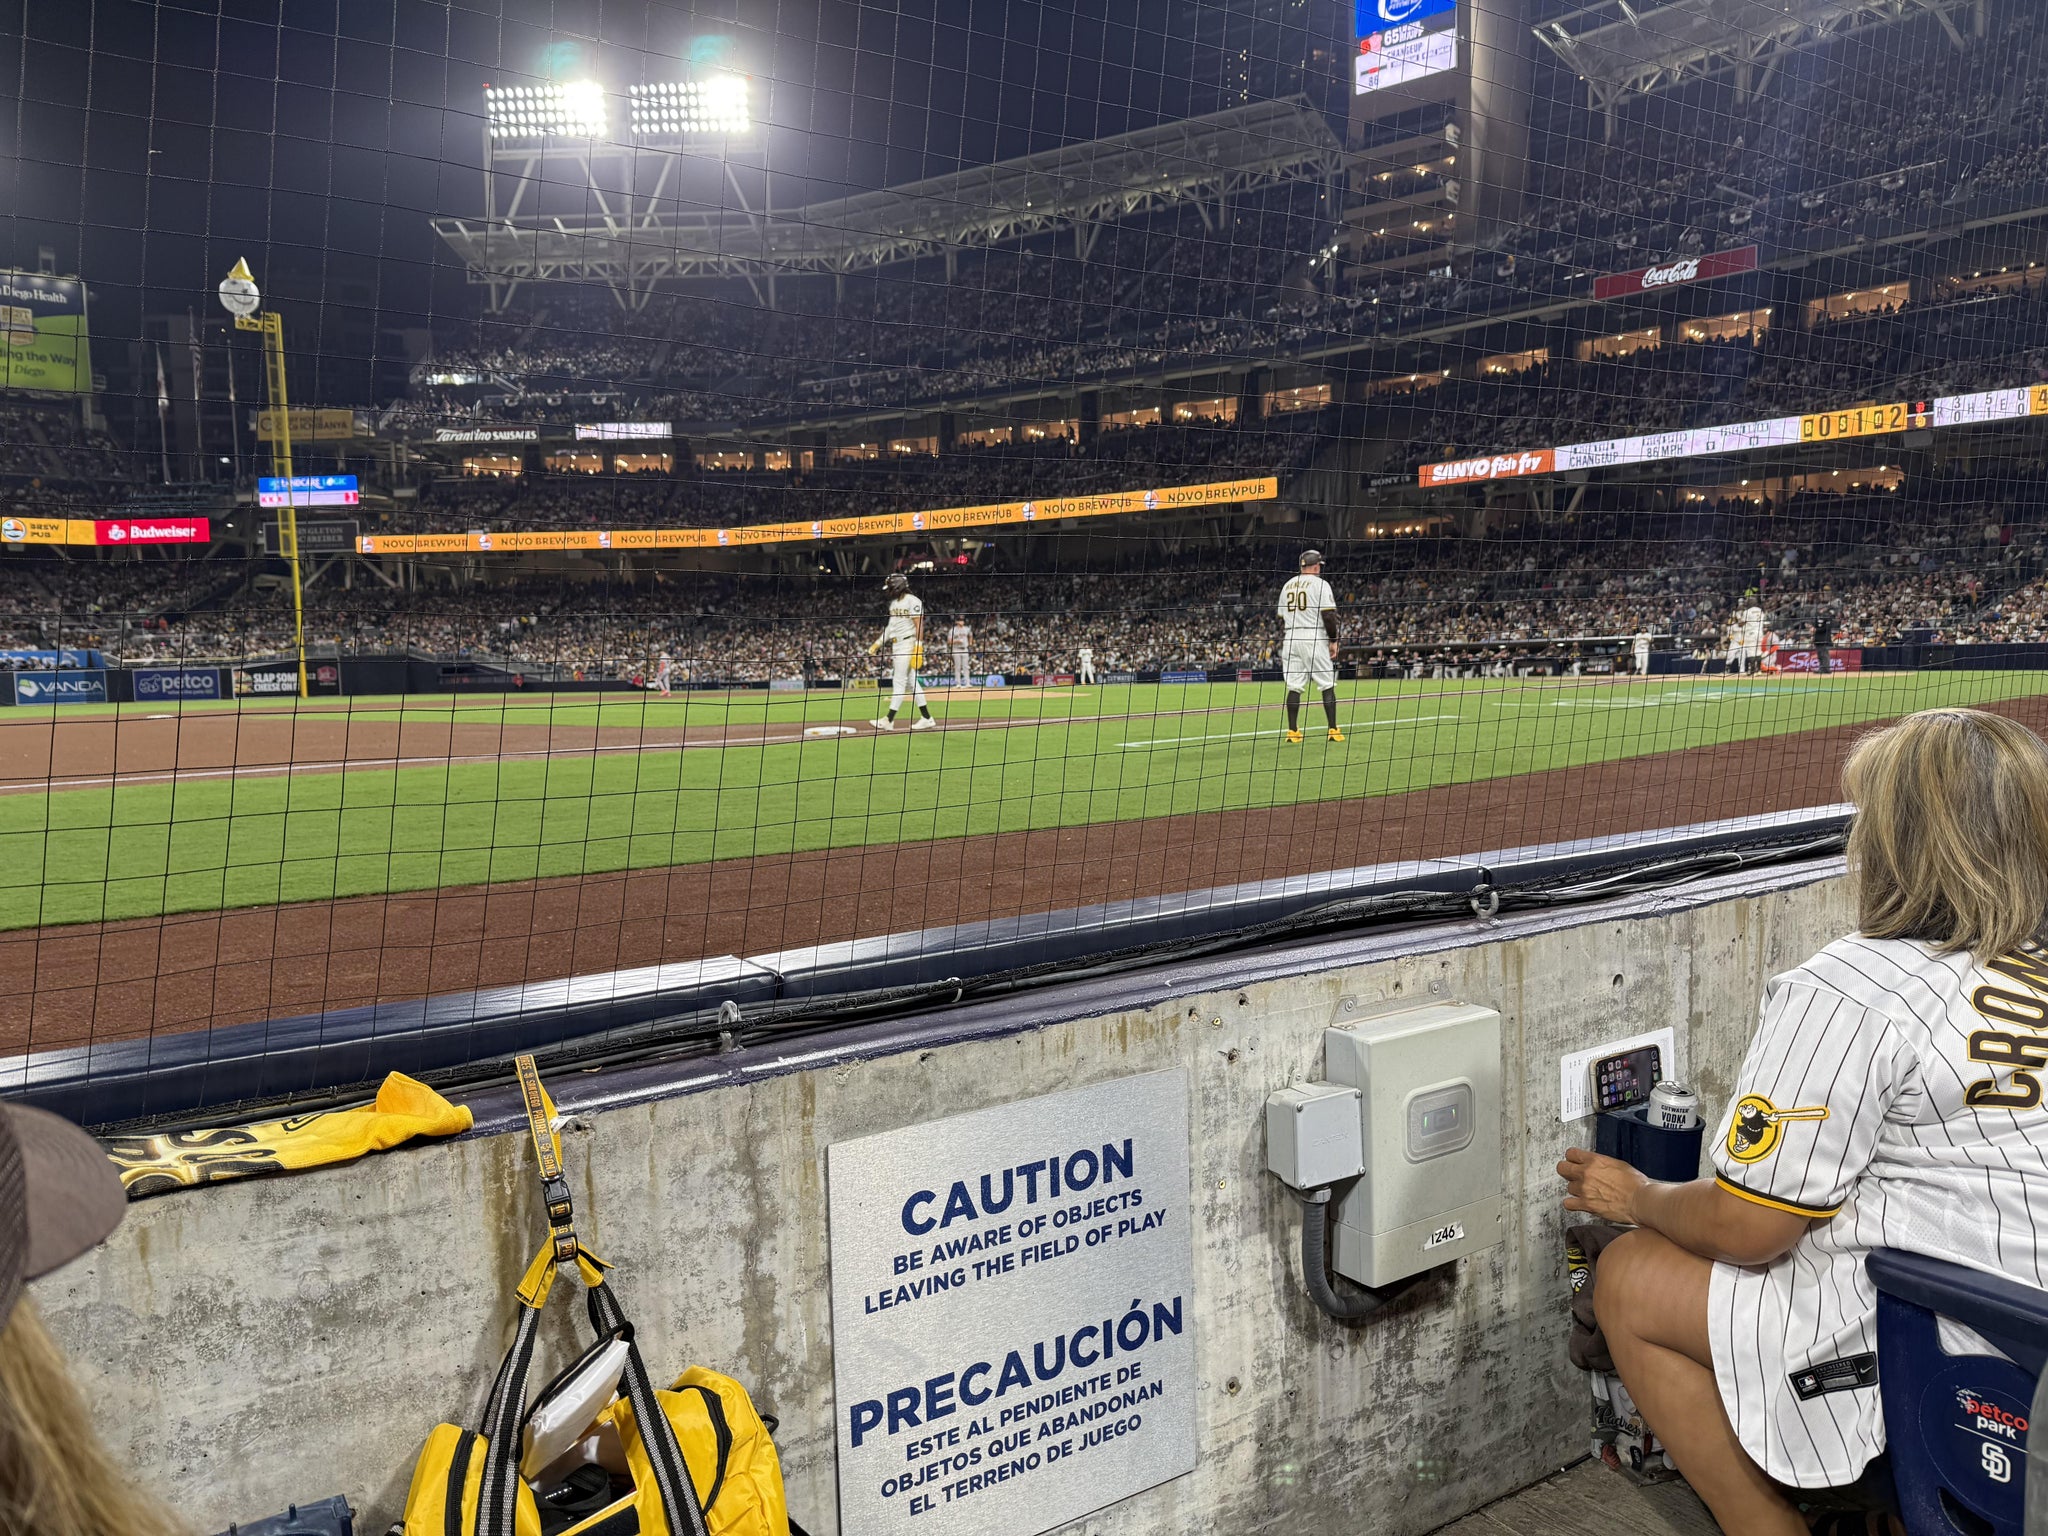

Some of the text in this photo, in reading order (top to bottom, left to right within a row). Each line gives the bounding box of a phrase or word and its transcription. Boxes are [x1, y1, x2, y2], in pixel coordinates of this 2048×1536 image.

[33, 288, 68, 304] Health
[26, 350, 48, 363] the
[50, 352, 76, 368] Way
[2018, 389, 2025, 401] 0
[1953, 410, 1961, 422] 0
[2018, 403, 2025, 415] 0
[2000, 398, 2007, 411] E
[1818, 415, 1831, 437] 0
[1856, 411, 1863, 432] 1
[1890, 406, 1902, 429] 2
[435, 428, 492, 442] Tarantino
[1661, 444, 1684, 457] MPH
[1431, 452, 1543, 482] SANYO fish fry
[1569, 451, 1619, 468] CHANGEUP
[1168, 484, 1266, 502] NOVO BREWPUB
[1044, 498, 1132, 515] NOVO BREWPUB
[829, 518, 904, 532] NOVO BREWPUB
[931, 509, 1012, 525] NOVO BREWPUB
[130, 525, 197, 538] Budweiser
[621, 534, 707, 544] NOVO BREWPUB
[382, 540, 414, 549] NOVO
[501, 536, 588, 546] NOVO BREWPUB
[1286, 591, 1307, 613] 20
[39, 679, 104, 692] VANDA
[161, 673, 214, 693] petco
[253, 673, 275, 683] SLAP
[253, 682, 280, 692] CHEESE
[281, 682, 293, 691] ON
[1963, 936, 2048, 1111] CRON
[1660, 1104, 1690, 1114] CUTWATER
[1661, 1111, 1687, 1125] VODKA
[543, 1154, 556, 1170] SAN
[901, 1138, 1134, 1236] CAUTION
[893, 1188, 1143, 1276] BE AWARE OF OBJECTS
[1430, 1226, 1456, 1245] 1246
[864, 1208, 1167, 1315] LEAVING THE FIELD OF PLAY
[849, 1295, 1184, 1449] PRECAUCIÓN
[906, 1361, 1142, 1462] ESTE AL PENDIENTE DE
[1966, 1398, 2029, 1432] petco
[1976, 1415, 2017, 1440] park
[880, 1379, 1164, 1498] OBJETOS QUE ABANDONAN
[909, 1413, 1142, 1517] EL TERRENO DE JUEGO
